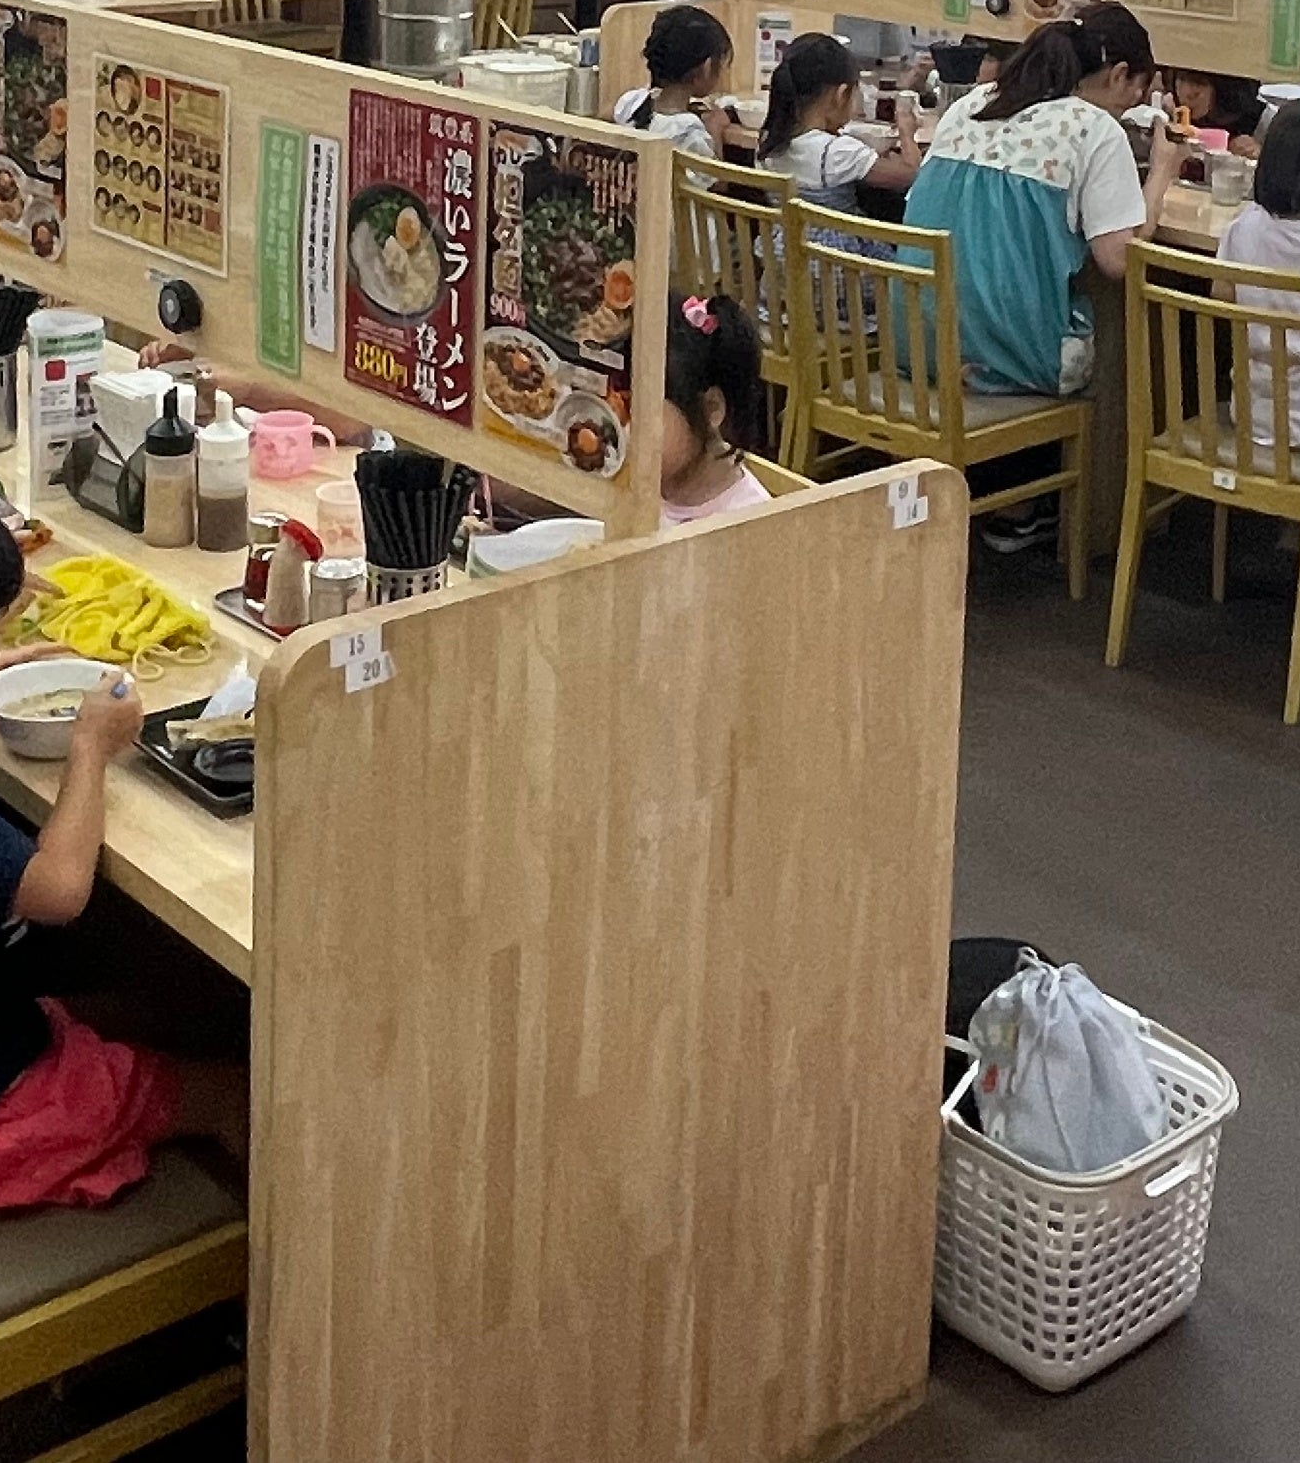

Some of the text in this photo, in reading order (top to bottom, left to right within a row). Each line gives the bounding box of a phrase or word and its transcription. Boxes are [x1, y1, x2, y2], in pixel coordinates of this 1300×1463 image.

[440, 147, 474, 412] 濃いラーメン
[348, 633, 366, 657] 15
[362, 658, 382, 682] 20
